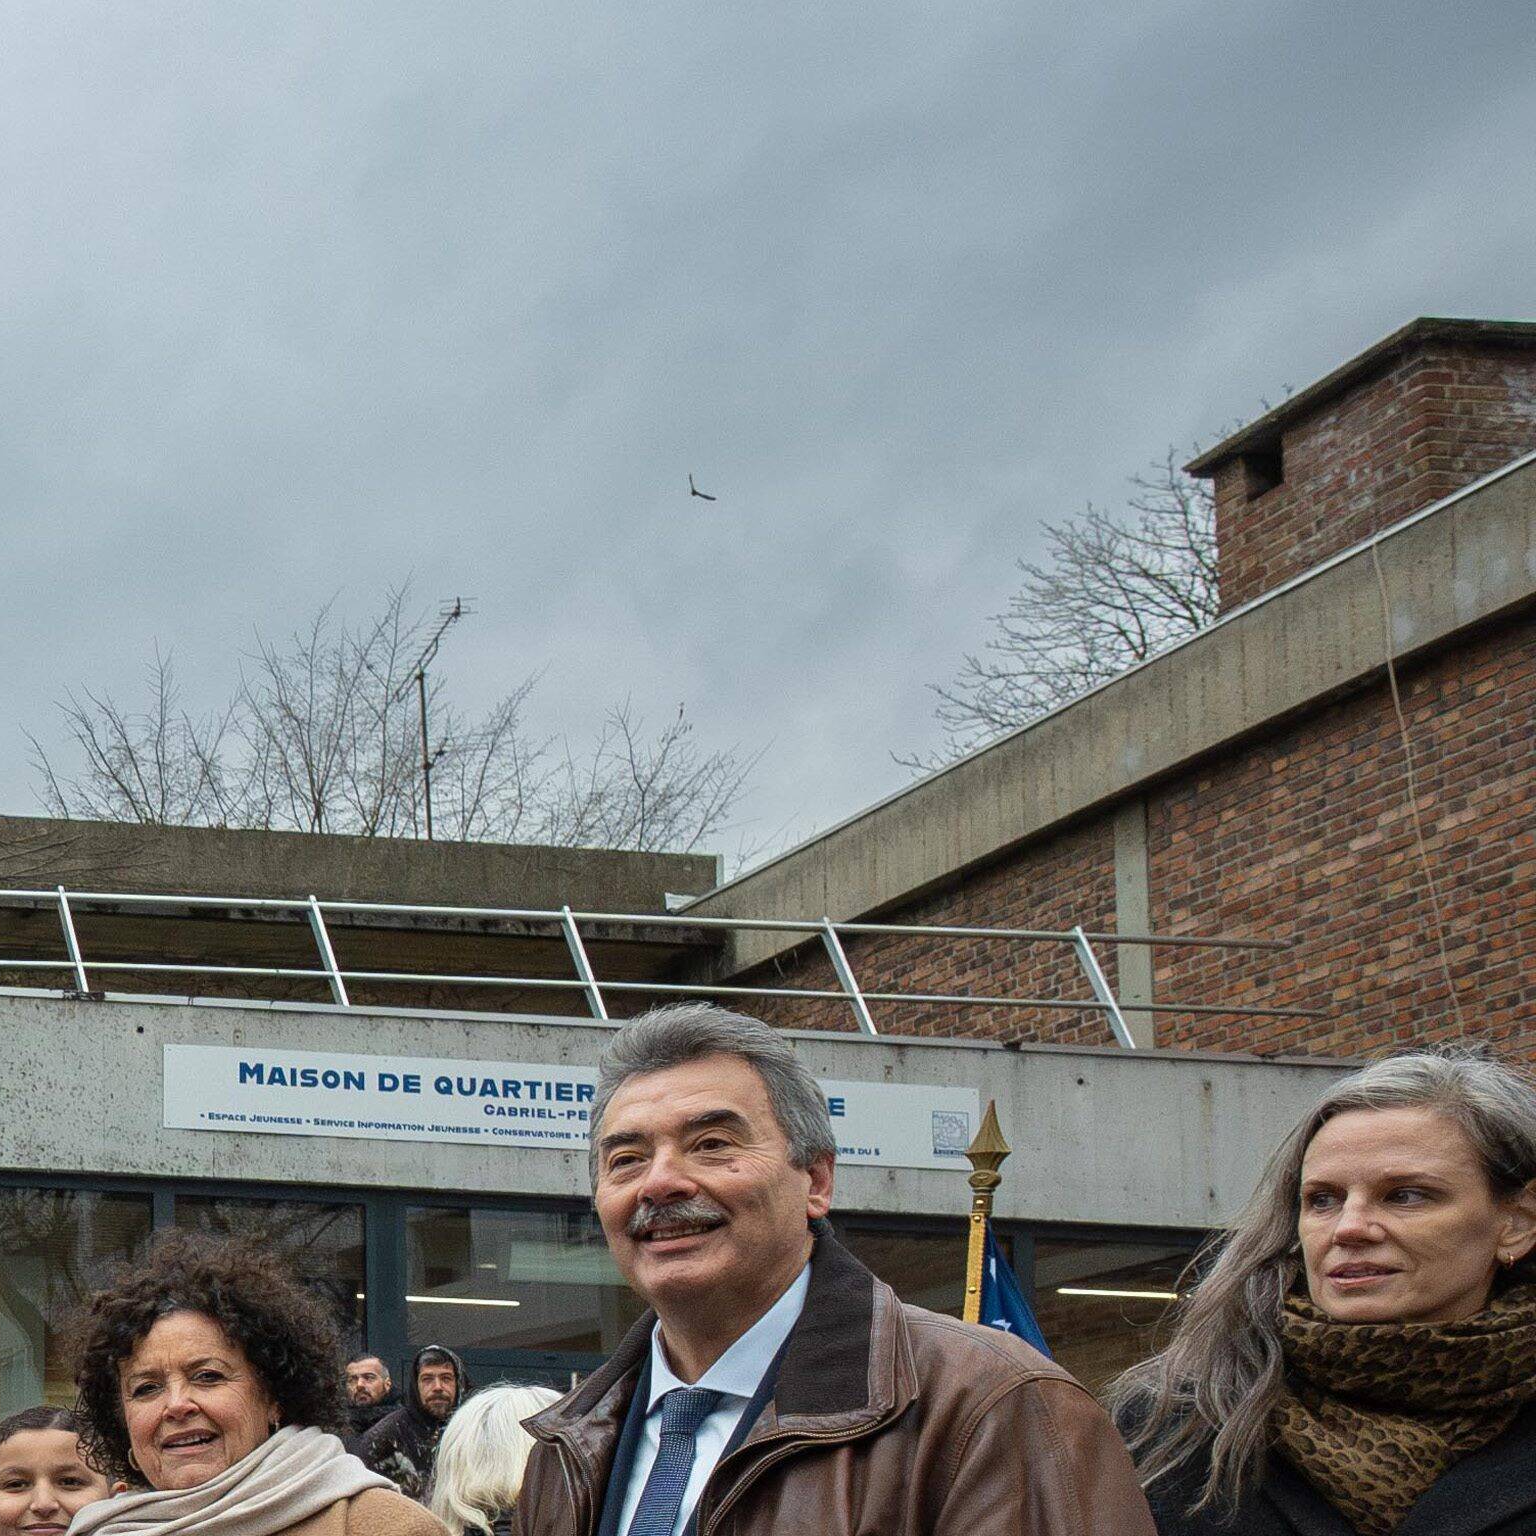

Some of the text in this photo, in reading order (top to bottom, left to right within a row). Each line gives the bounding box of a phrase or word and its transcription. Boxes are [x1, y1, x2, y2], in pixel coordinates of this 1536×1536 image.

[238, 1062, 596, 1103] MAISON DE QUARTIER
[484, 1104, 589, 1121] GABRIEL-PE
[208, 1112, 247, 1122] ESPACE
[249, 1114, 303, 1125] JEUNESSE
[313, 1117, 355, 1128] SERVICE
[357, 1120, 425, 1132] INFORMATION
[428, 1124, 481, 1134] JEUNESSE
[492, 1127, 571, 1140] CONSERVATOIRE
[858, 1147, 872, 1156] DU
